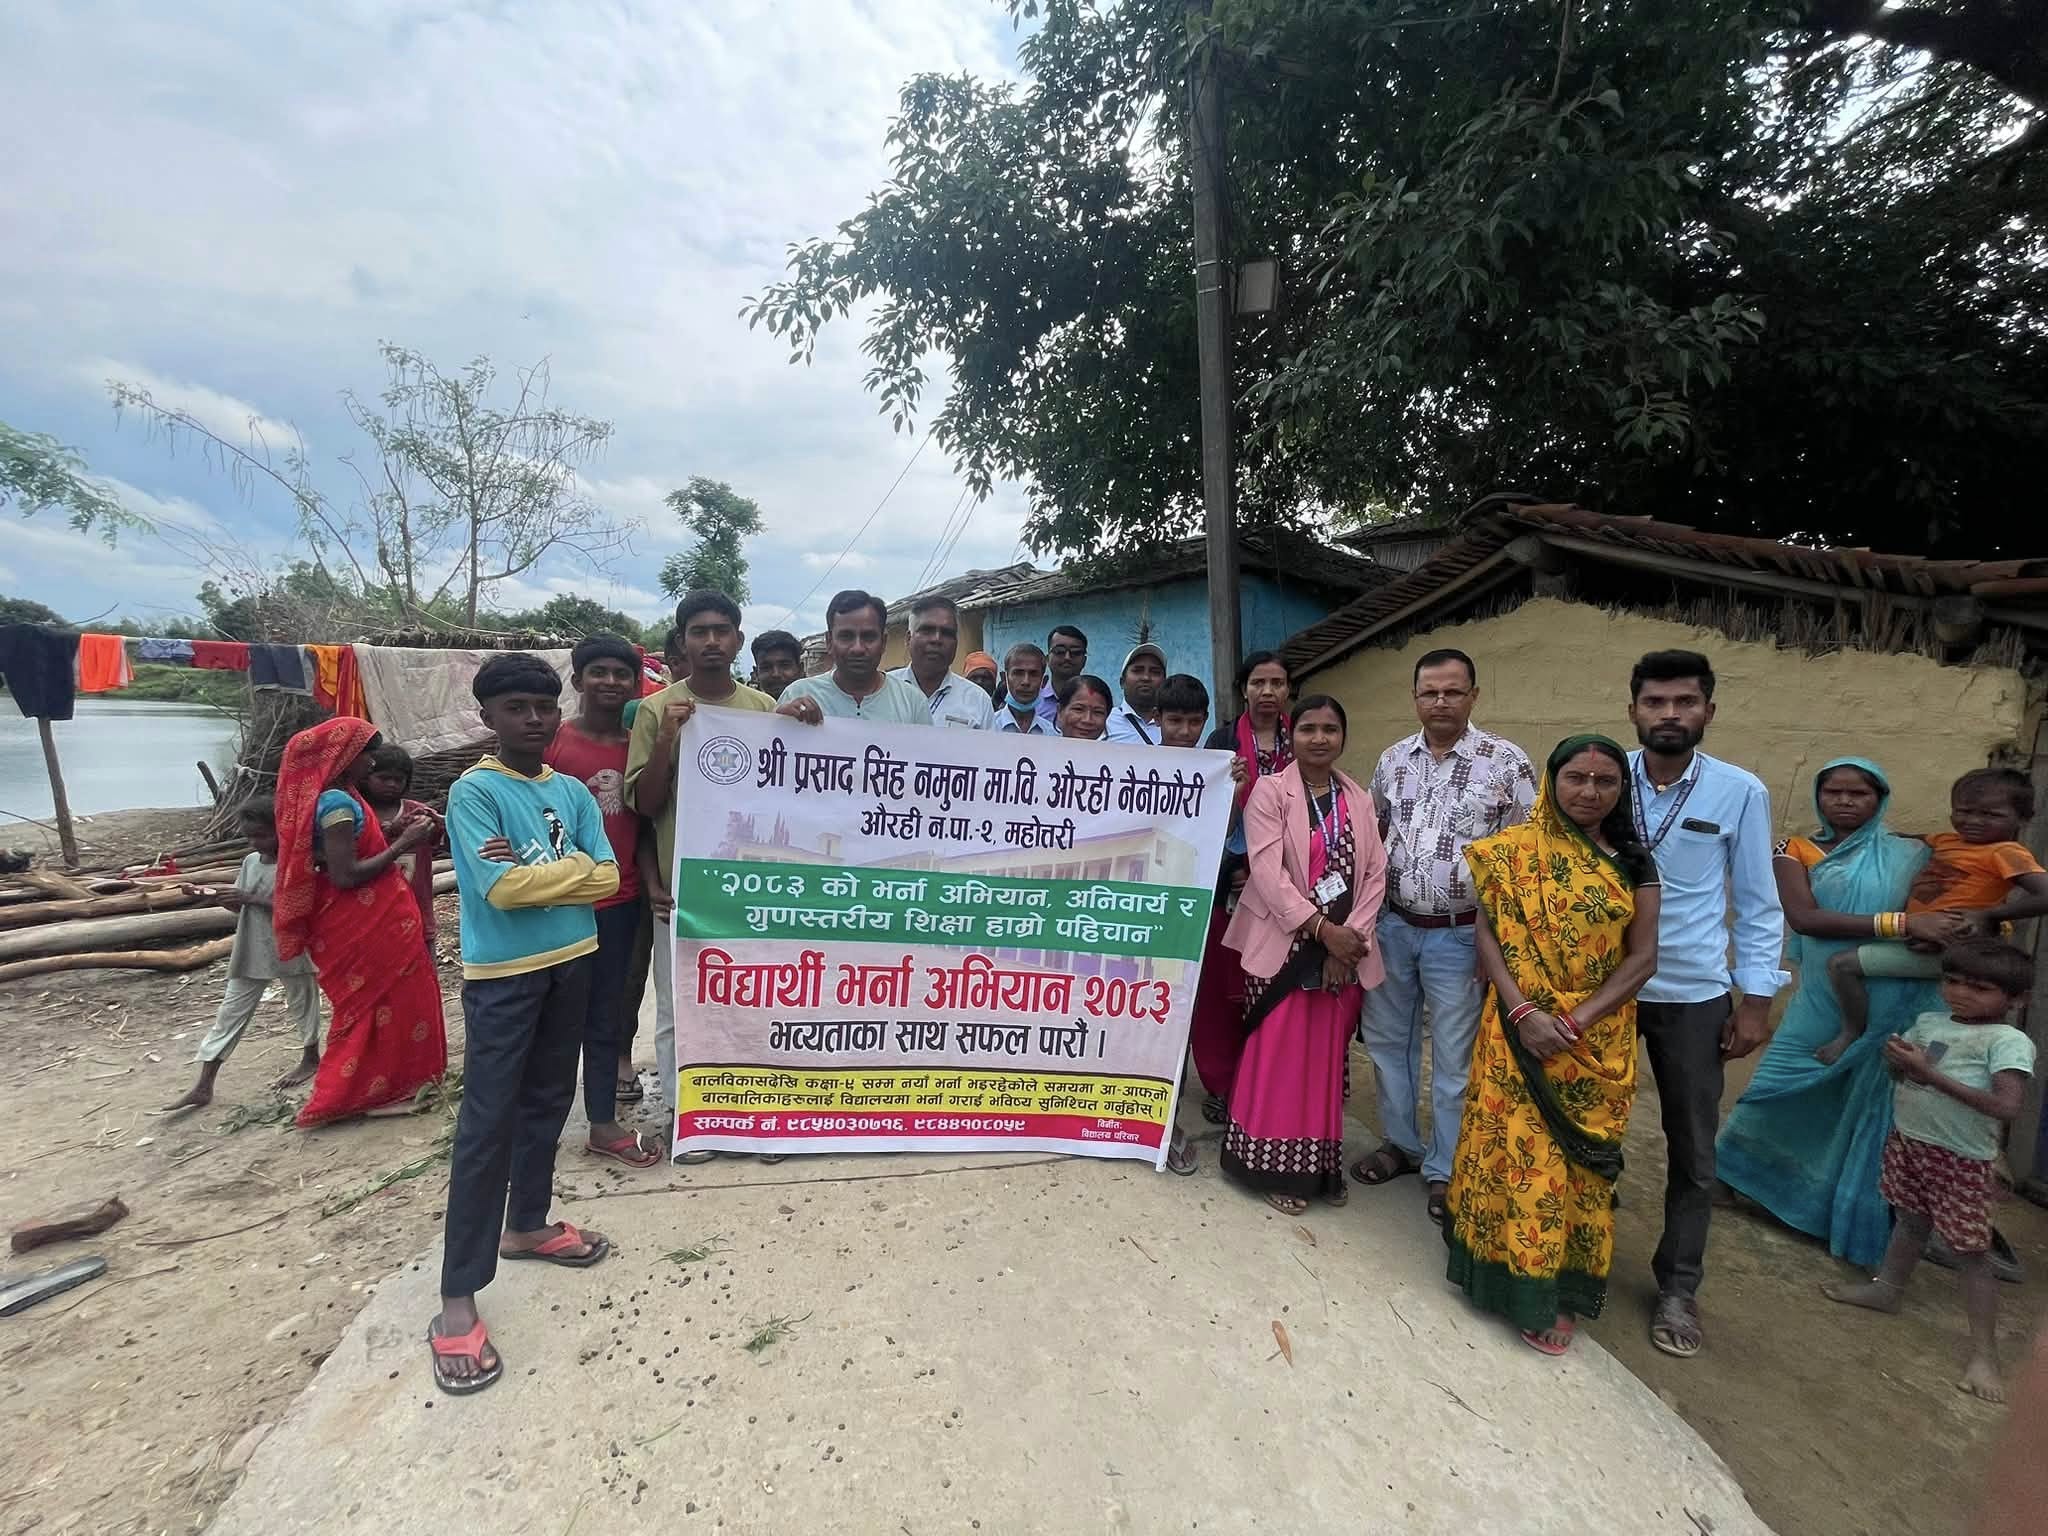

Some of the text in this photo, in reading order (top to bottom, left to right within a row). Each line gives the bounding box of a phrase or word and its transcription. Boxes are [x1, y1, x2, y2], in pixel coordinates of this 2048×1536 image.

[757, 737, 787, 788] श्री
[794, 752, 856, 795] प्रसाद
[863, 744, 908, 799] सिंह
[914, 762, 978, 812] नमुना
[984, 756, 1039, 806] मा.वि.
[1047, 760, 1113, 815] औरही
[1118, 765, 1205, 819] नैनीगौरी
[860, 803, 922, 840] औरही
[1004, 815, 1076, 850] महोत्तरी
[821, 871, 860, 898] को
[871, 878, 928, 902] भर्ना
[938, 879, 1053, 909] अभियान,
[1065, 886, 1169, 915] अनिवार्य
[1178, 897, 1198, 917] र
[744, 904, 894, 932] गुणस्तरीय
[905, 908, 975, 935] शिक्षा
[985, 911, 1047, 938] हाम्रो
[696, 946, 1172, 1025] विद्यार्थी भर्ना अभियान २०८३
[769, 1020, 888, 1053] भव्यताका
[895, 1021, 949, 1054] साथ
[956, 1022, 1032, 1055] सफल
[691, 1072, 799, 1089] बालविकासदेखि
[862, 1078, 895, 1089] सम्म
[901, 1074, 930, 1089] नयाँ
[935, 1076, 961, 1089] भर्ना
[1044, 1081, 1095, 1096] समयमा
[840, 1091, 910, 1106] विद्यालयमा
[916, 1092, 943, 1106] भर्ना
[949, 1093, 983, 1108] गराई
[989, 1093, 1032, 1108] भविष्य
[1038, 1095, 1099, 1112] सुनिश्चित
[1103, 1098, 1154, 1119] गर्नुहोस्
[693, 1115, 755, 1131] सम्पर्क
